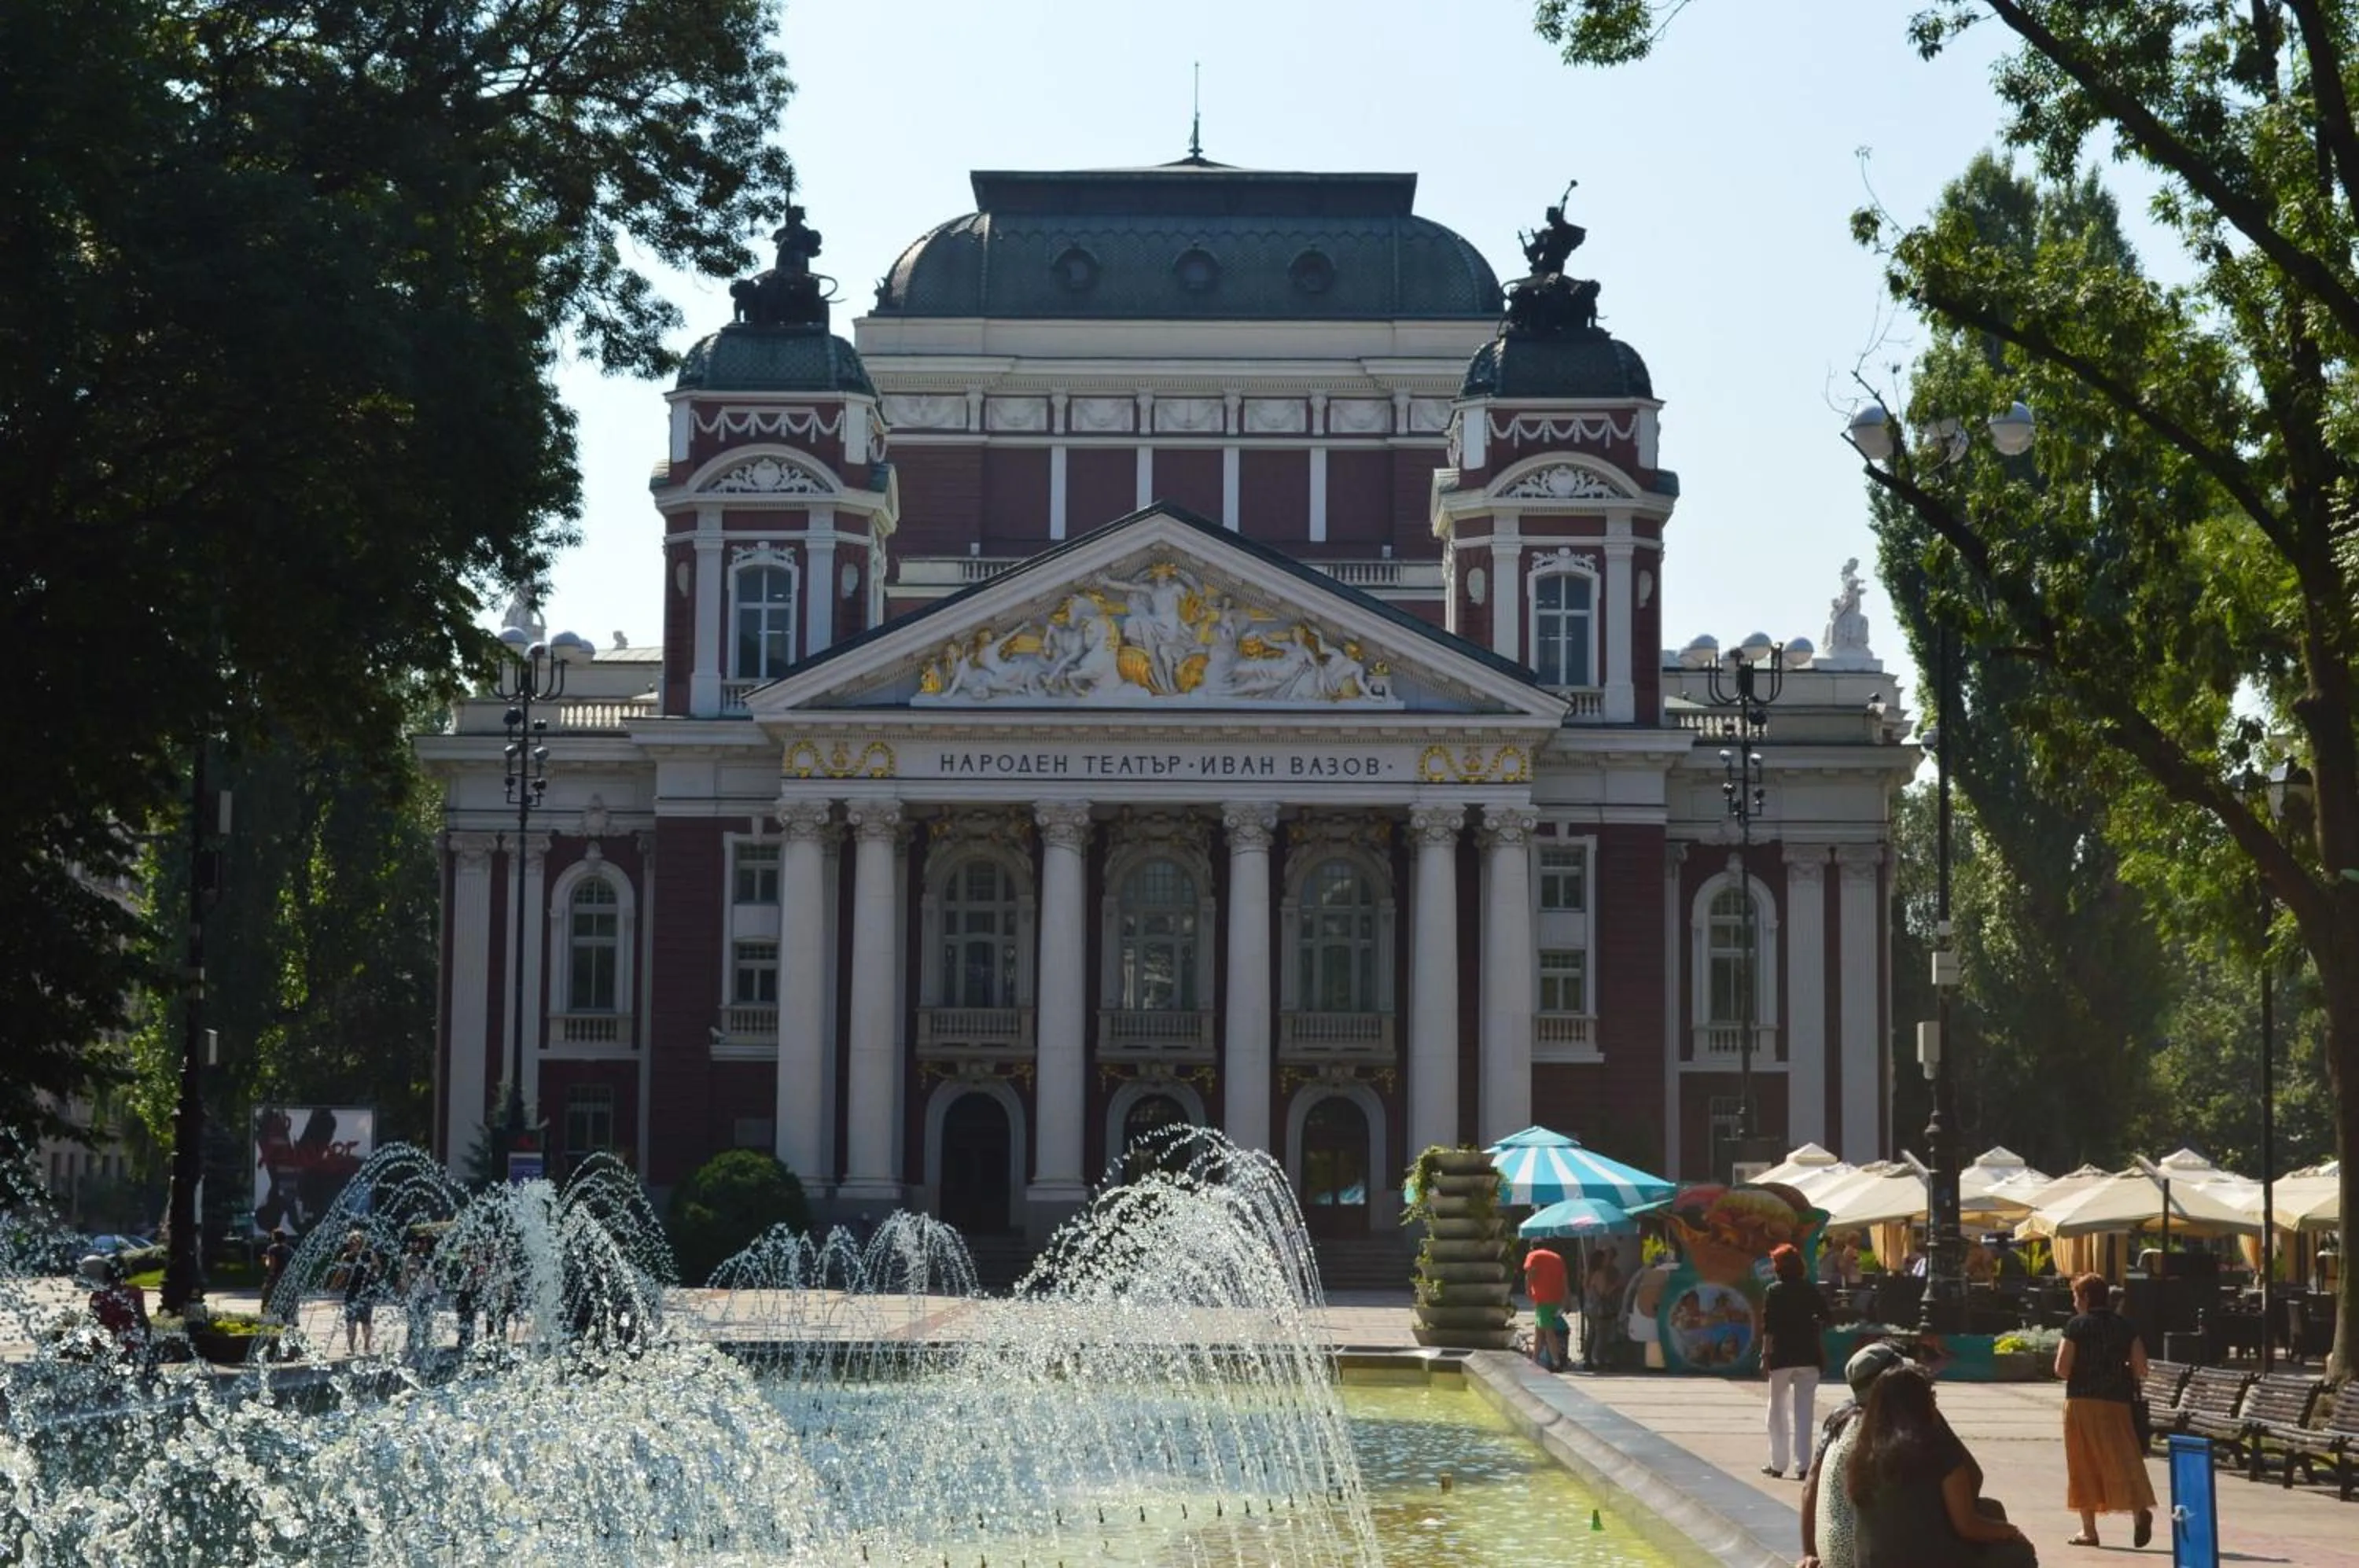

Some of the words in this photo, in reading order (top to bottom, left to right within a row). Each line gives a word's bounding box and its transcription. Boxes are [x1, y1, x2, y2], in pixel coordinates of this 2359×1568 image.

[940, 753, 1068, 773] НАРОДЕН
[1082, 755, 1180, 775] ТЕАТЪР
[1201, 755, 1274, 775] ИВАН
[1290, 756, 1380, 775] ВАЗОВ
